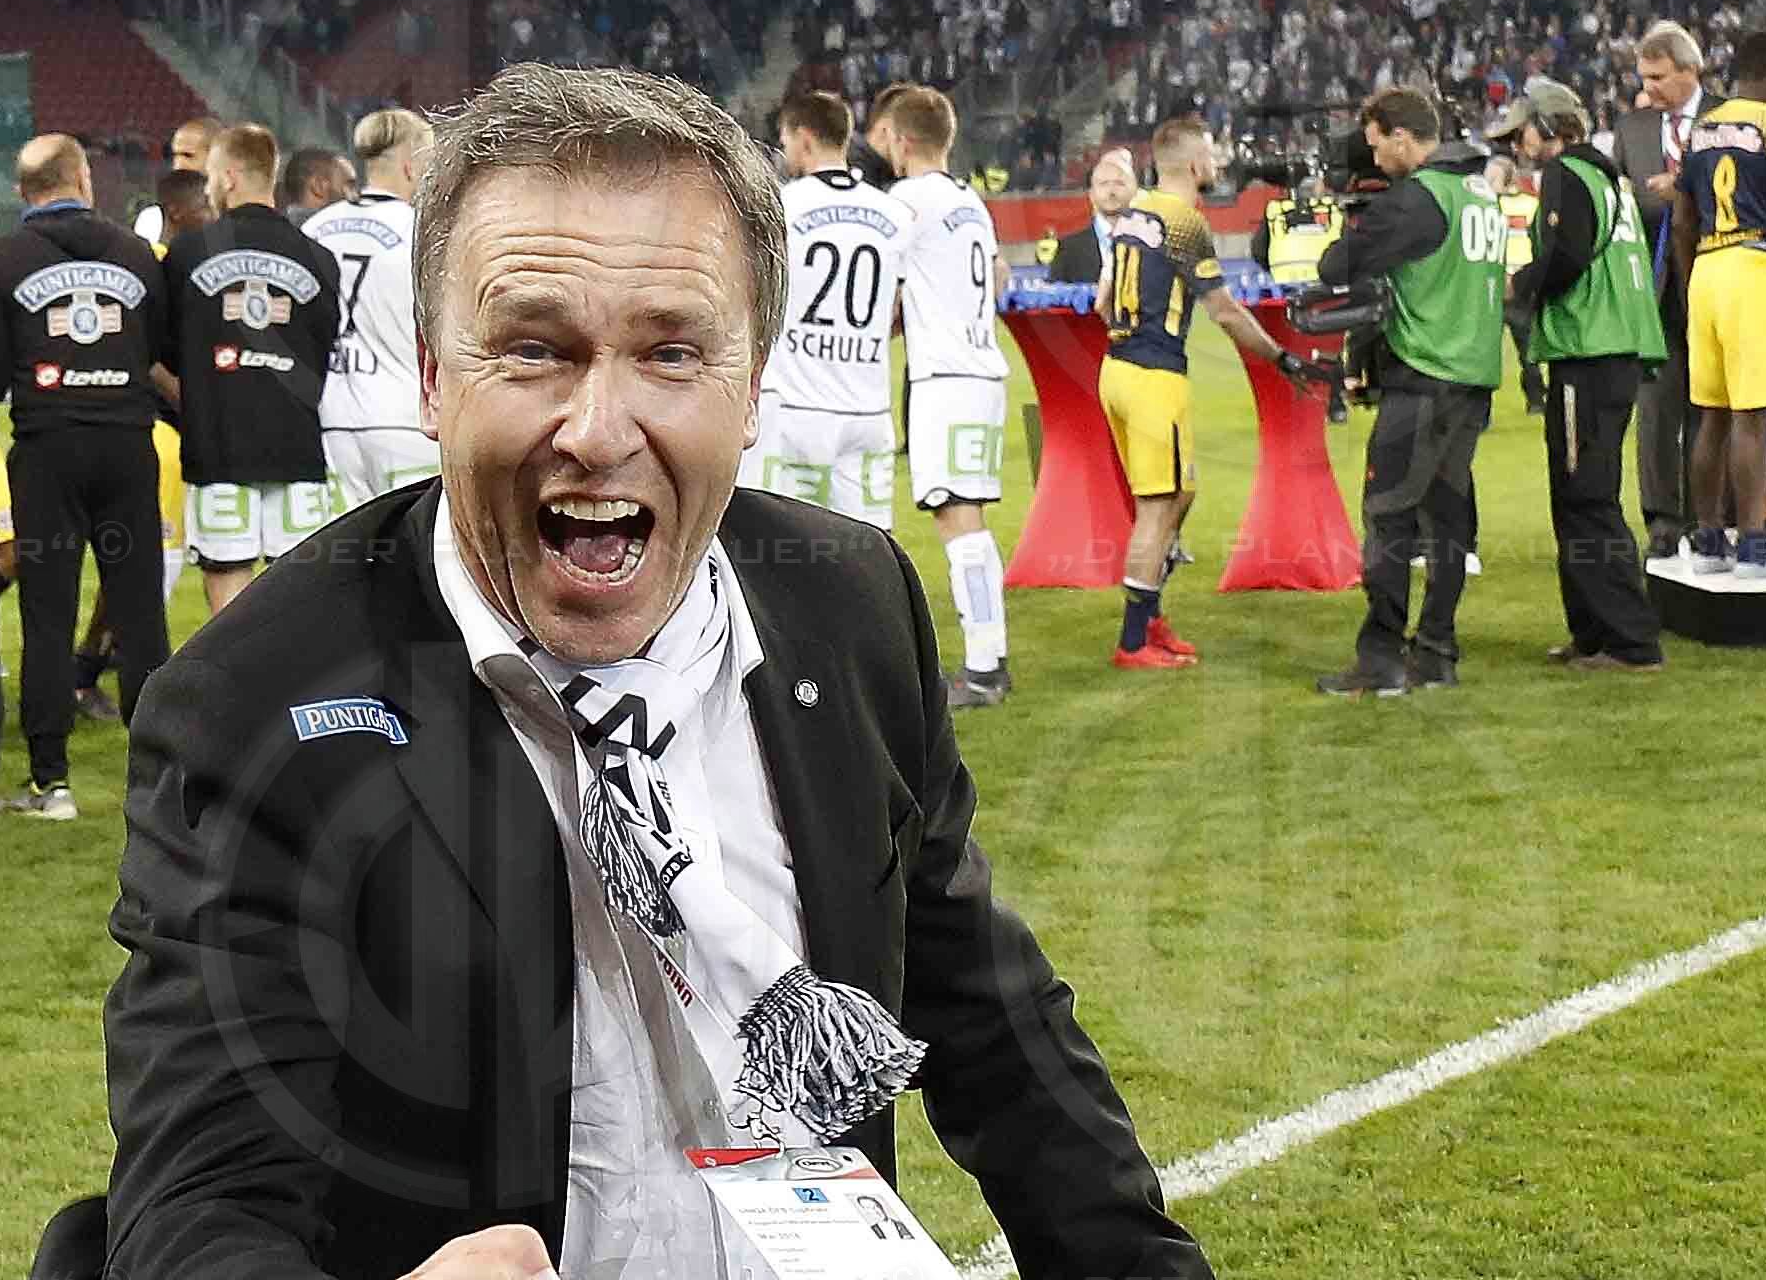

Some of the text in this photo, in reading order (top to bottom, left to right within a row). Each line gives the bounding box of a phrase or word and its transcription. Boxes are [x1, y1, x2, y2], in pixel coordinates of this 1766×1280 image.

[21, 266, 140, 309] PUNTIGAMER
[197, 255, 314, 297] PUNTIGAMER
[341, 252, 372, 338] 7
[799, 240, 882, 330] 20
[785, 328, 883, 364] SCHULZ
[305, 706, 397, 741] PUNTIGA
[802, 1188, 820, 1202] 2
